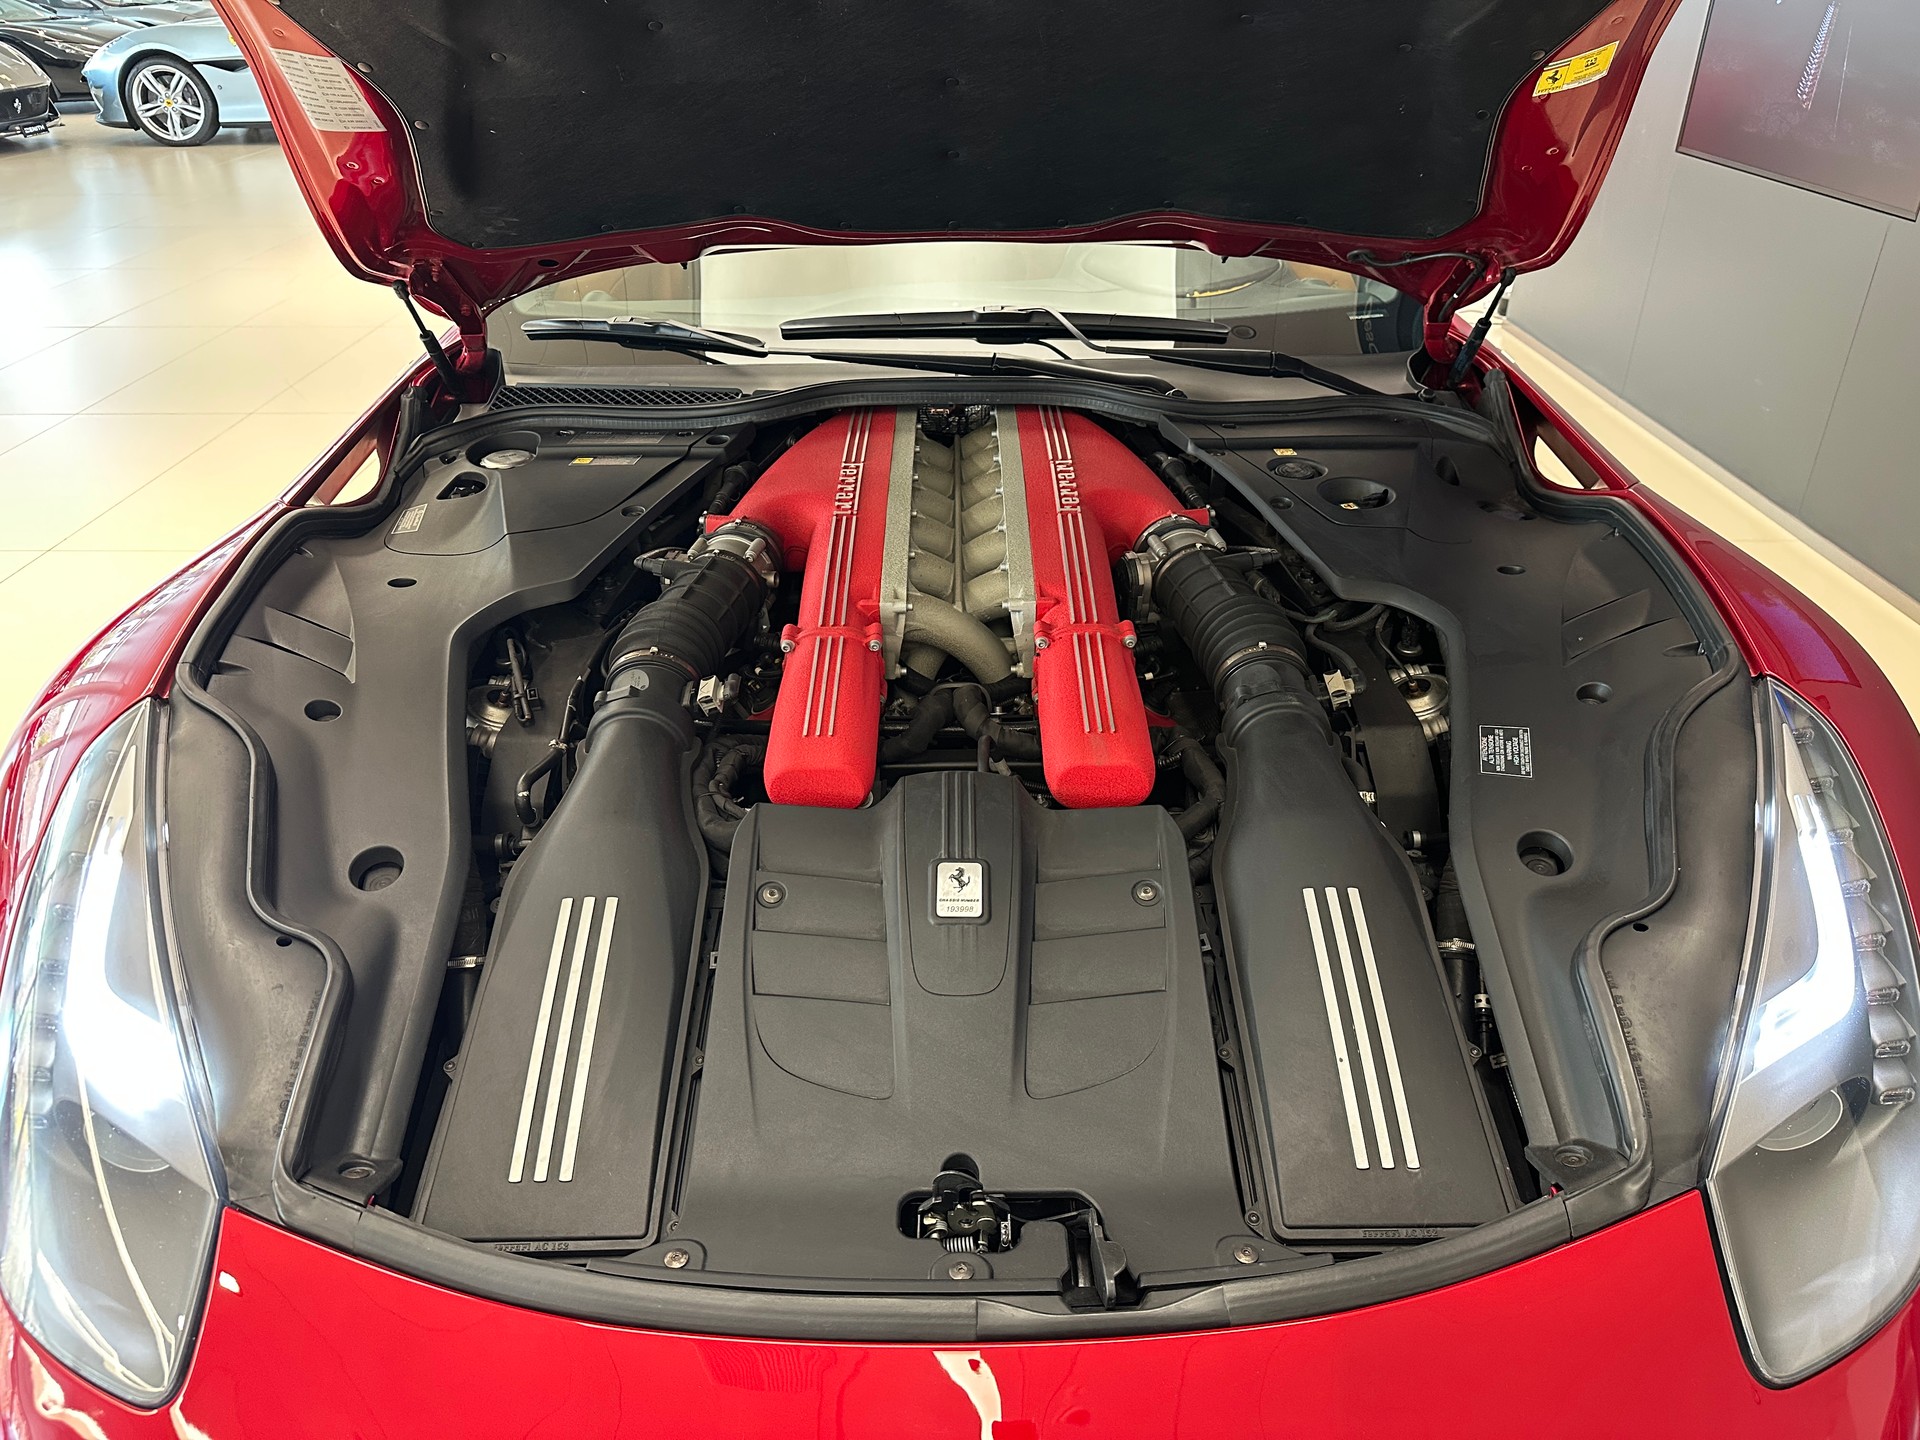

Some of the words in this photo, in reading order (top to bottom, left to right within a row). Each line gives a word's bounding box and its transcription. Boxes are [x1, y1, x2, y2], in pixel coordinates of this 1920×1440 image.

[833, 462, 864, 515] Ferrari
[1050, 460, 1081, 513] Ferrari
[946, 905, 974, 913] 193998
[534, 1242, 549, 1251] AC
